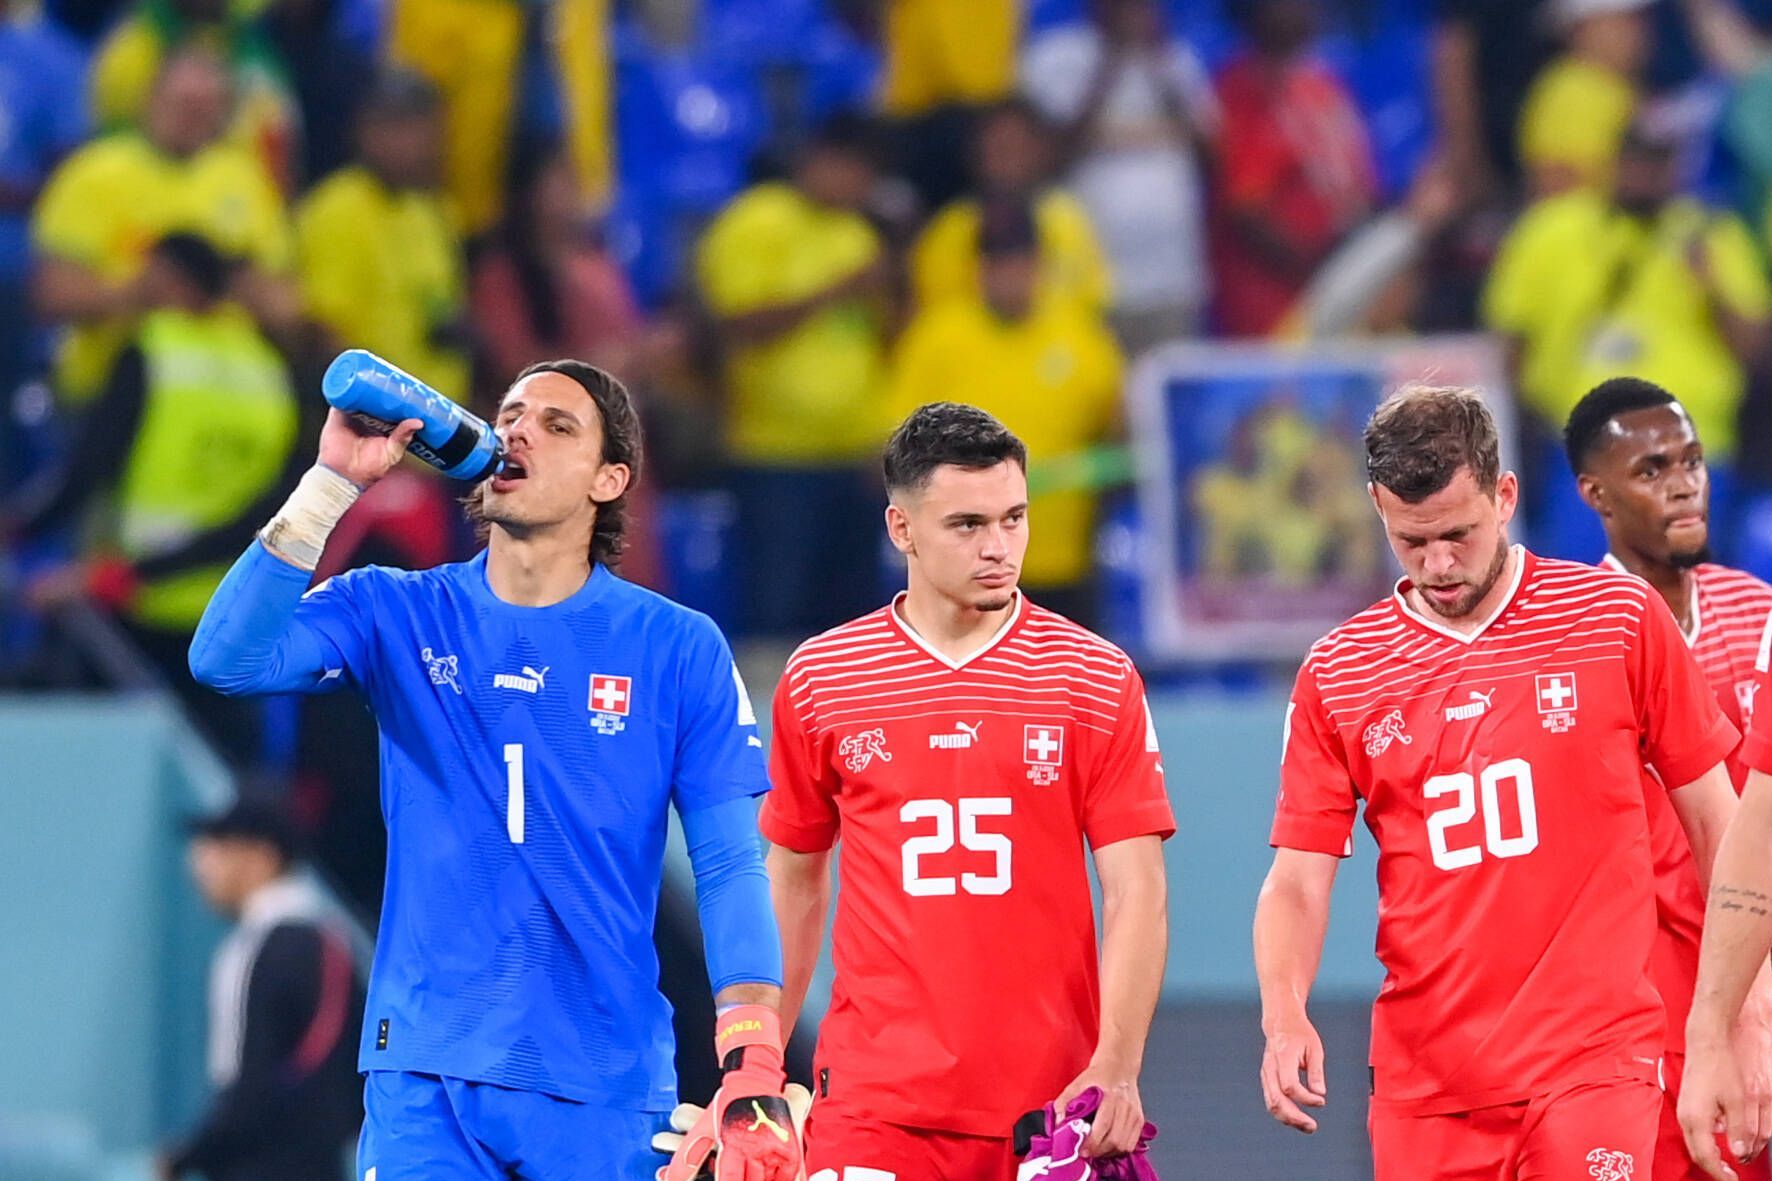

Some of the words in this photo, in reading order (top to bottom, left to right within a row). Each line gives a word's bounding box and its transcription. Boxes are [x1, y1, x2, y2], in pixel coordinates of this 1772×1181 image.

[351, 412, 446, 467] POWADE
[493, 674, 538, 693] PUMA
[1445, 703, 1485, 723] PUMA
[929, 733, 971, 749] PUMA
[503, 743, 525, 844] 1
[1423, 757, 1539, 871] 20
[900, 797, 1012, 896] 25
